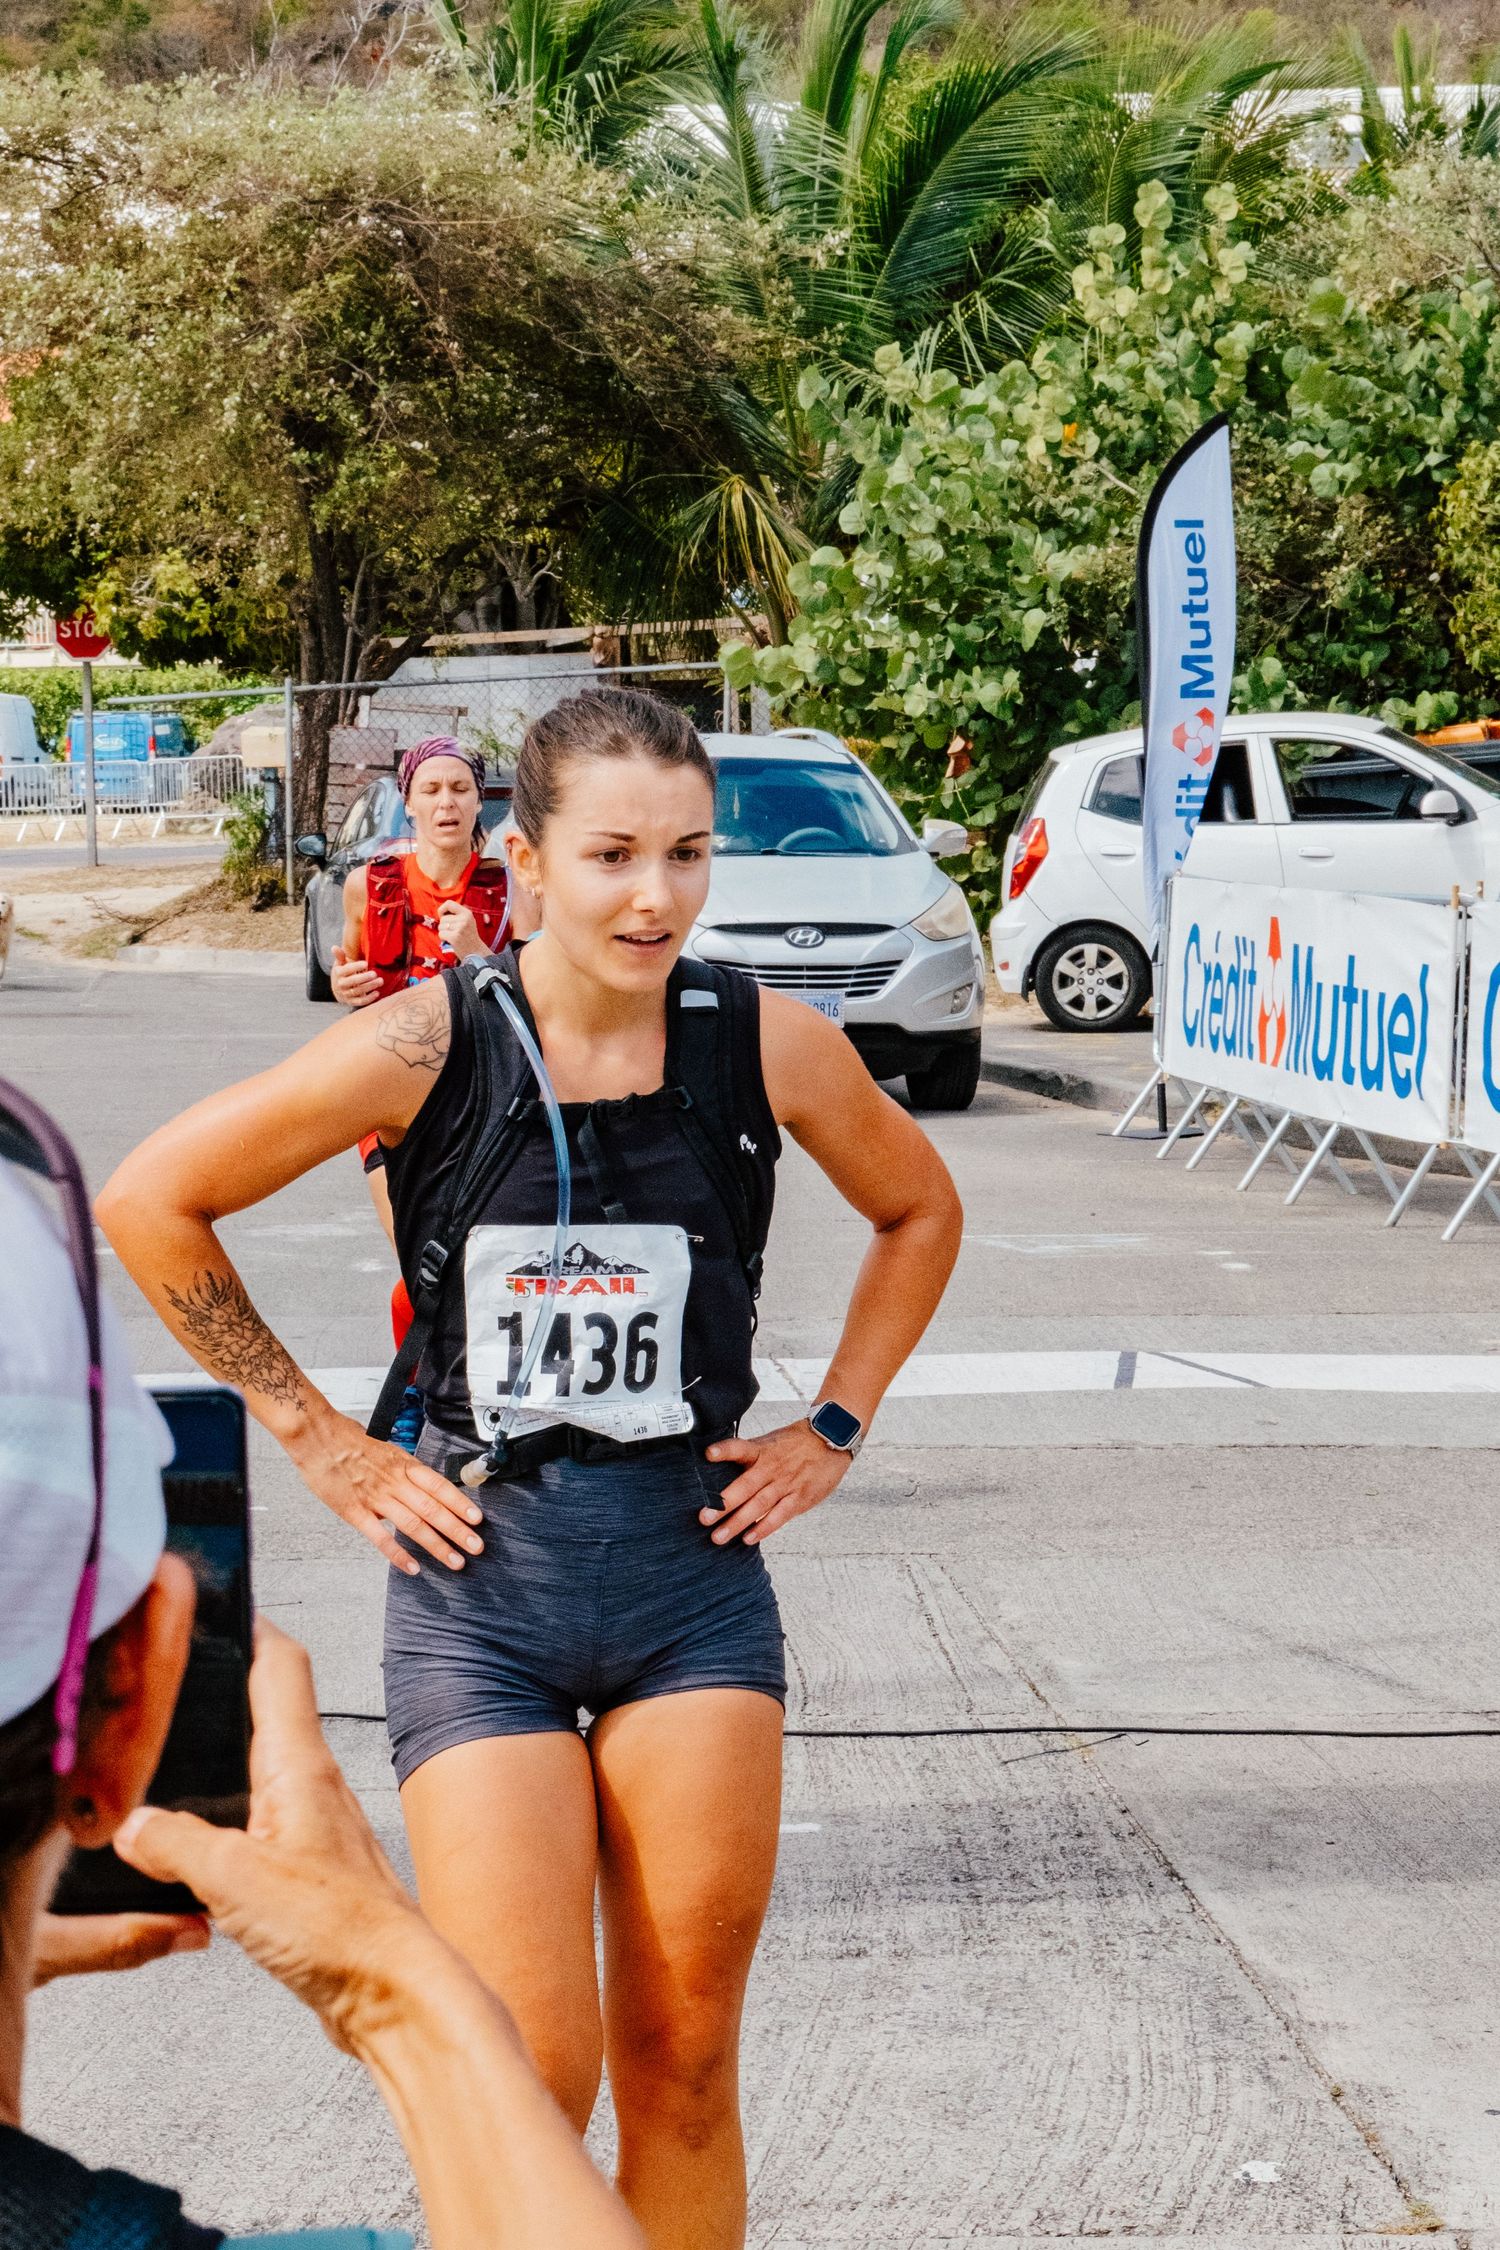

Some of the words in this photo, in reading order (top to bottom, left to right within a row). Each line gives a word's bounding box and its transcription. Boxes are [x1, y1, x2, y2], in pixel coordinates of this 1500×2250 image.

[1174, 519, 1215, 700] Mutuel
[59, 620, 95, 638] STO
[1183, 922, 1257, 1062] Crédit
[1285, 943, 1430, 1101] Mutuel
[541, 1265, 616, 1275] DREAM
[505, 1277, 648, 1297] TRAIL
[496, 1311, 659, 1397] 1436
[633, 1425, 648, 1436] 1436
